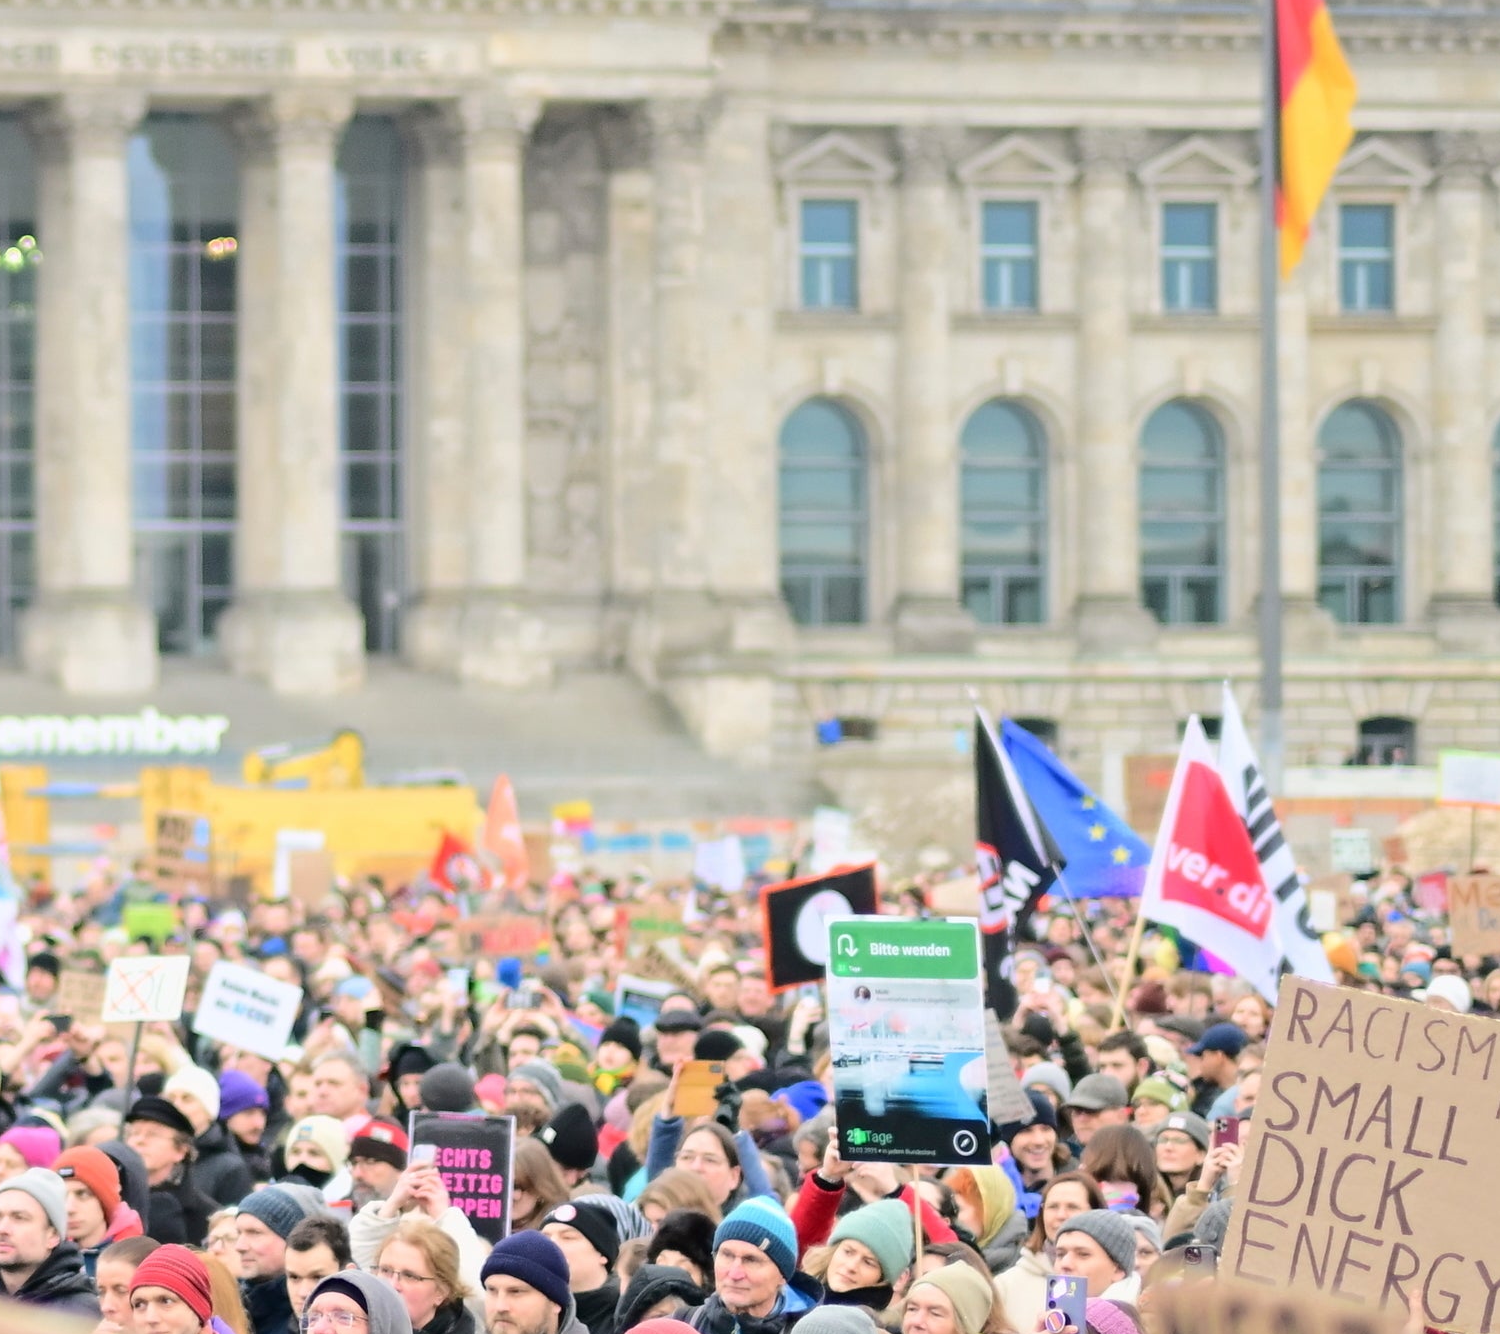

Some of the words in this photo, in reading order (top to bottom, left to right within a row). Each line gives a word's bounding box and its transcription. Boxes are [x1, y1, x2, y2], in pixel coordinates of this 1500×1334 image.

[1165, 841, 1273, 929] ver.di
[869, 942, 899, 956] Bitte
[901, 943, 951, 957] wenden
[1286, 986, 1498, 1081] RACISM
[434, 1147, 493, 1170] ECHTS
[1264, 1070, 1468, 1166] SMALL
[441, 1172, 504, 1195] EITIG
[1248, 1131, 1425, 1236] DICK
